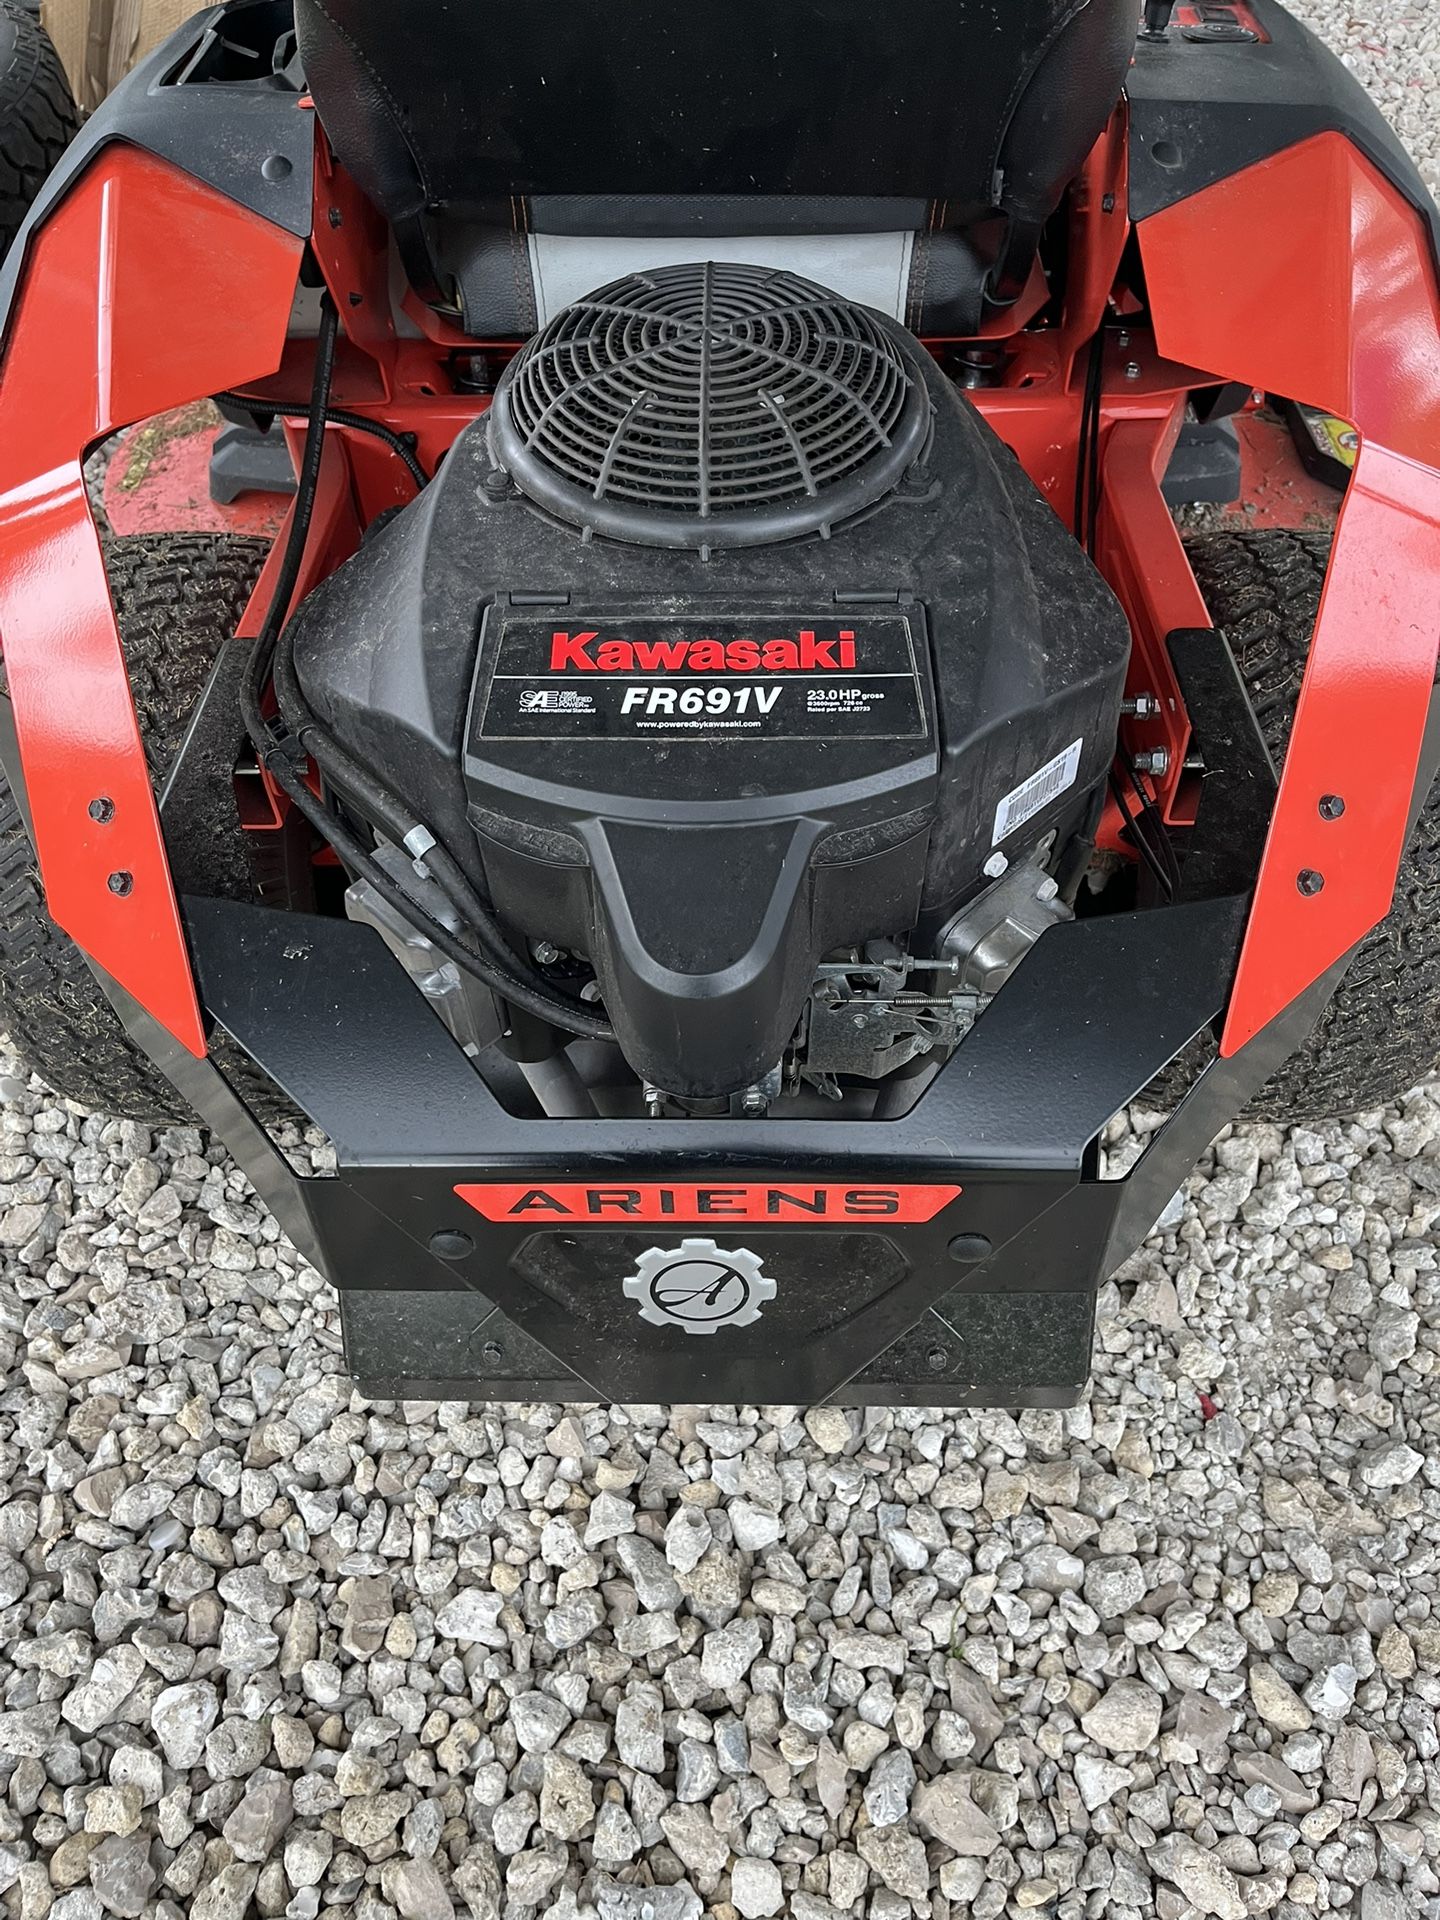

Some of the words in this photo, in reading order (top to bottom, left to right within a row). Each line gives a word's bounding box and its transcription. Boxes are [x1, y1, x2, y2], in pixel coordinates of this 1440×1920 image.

[550, 630, 857, 671] Kawasaki
[519, 690, 559, 708] SAE
[619, 686, 784, 716] FR691V
[807, 689, 838, 701] 23.0
[838, 689, 862, 701] HP
[861, 693, 885, 701] gross
[636, 720, 761, 730] www.poweredbykawasaki.com
[507, 1188, 901, 1216] ARIENS
